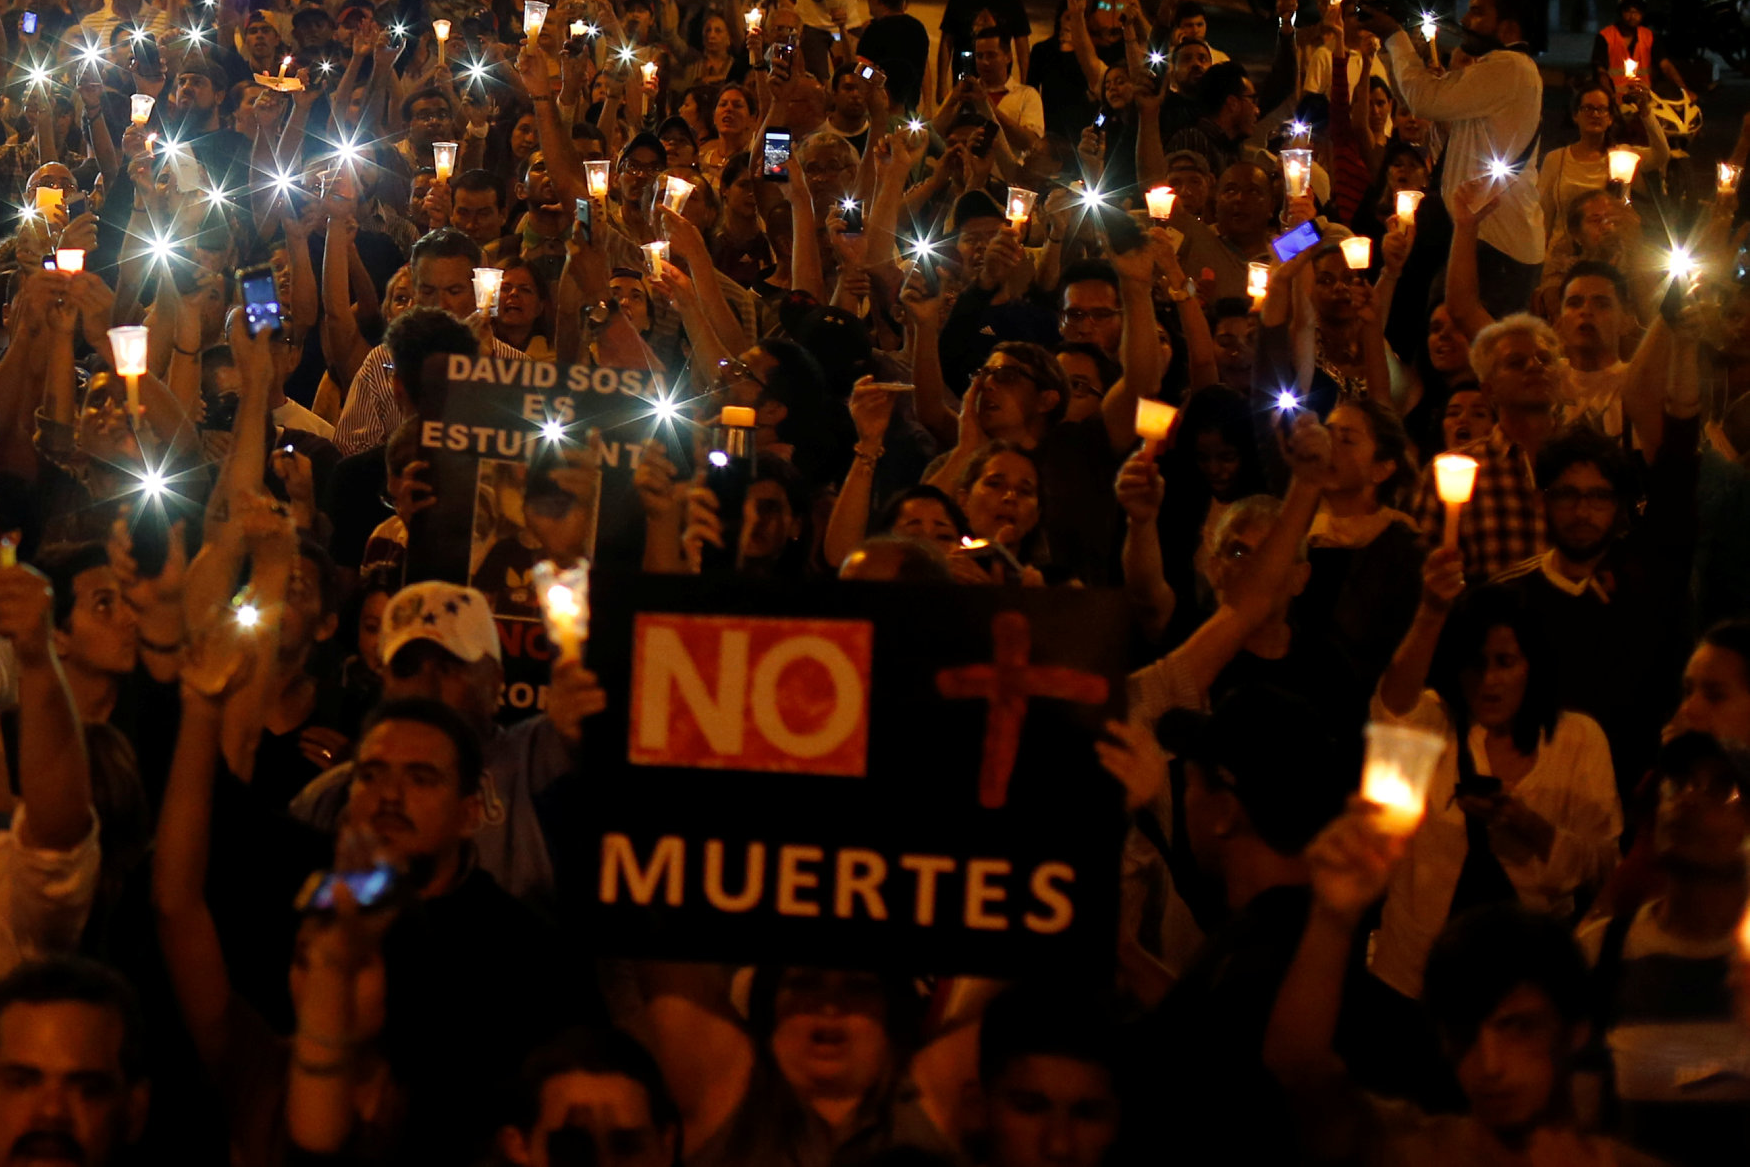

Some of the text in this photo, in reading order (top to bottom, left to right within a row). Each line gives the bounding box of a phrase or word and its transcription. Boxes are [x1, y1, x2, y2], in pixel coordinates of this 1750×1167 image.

[447, 353, 667, 398] DAVID SOSA
[521, 392, 575, 423] ES
[499, 621, 553, 662] NO
[639, 626, 864, 759] NO
[598, 832, 1076, 934] MUERTES
